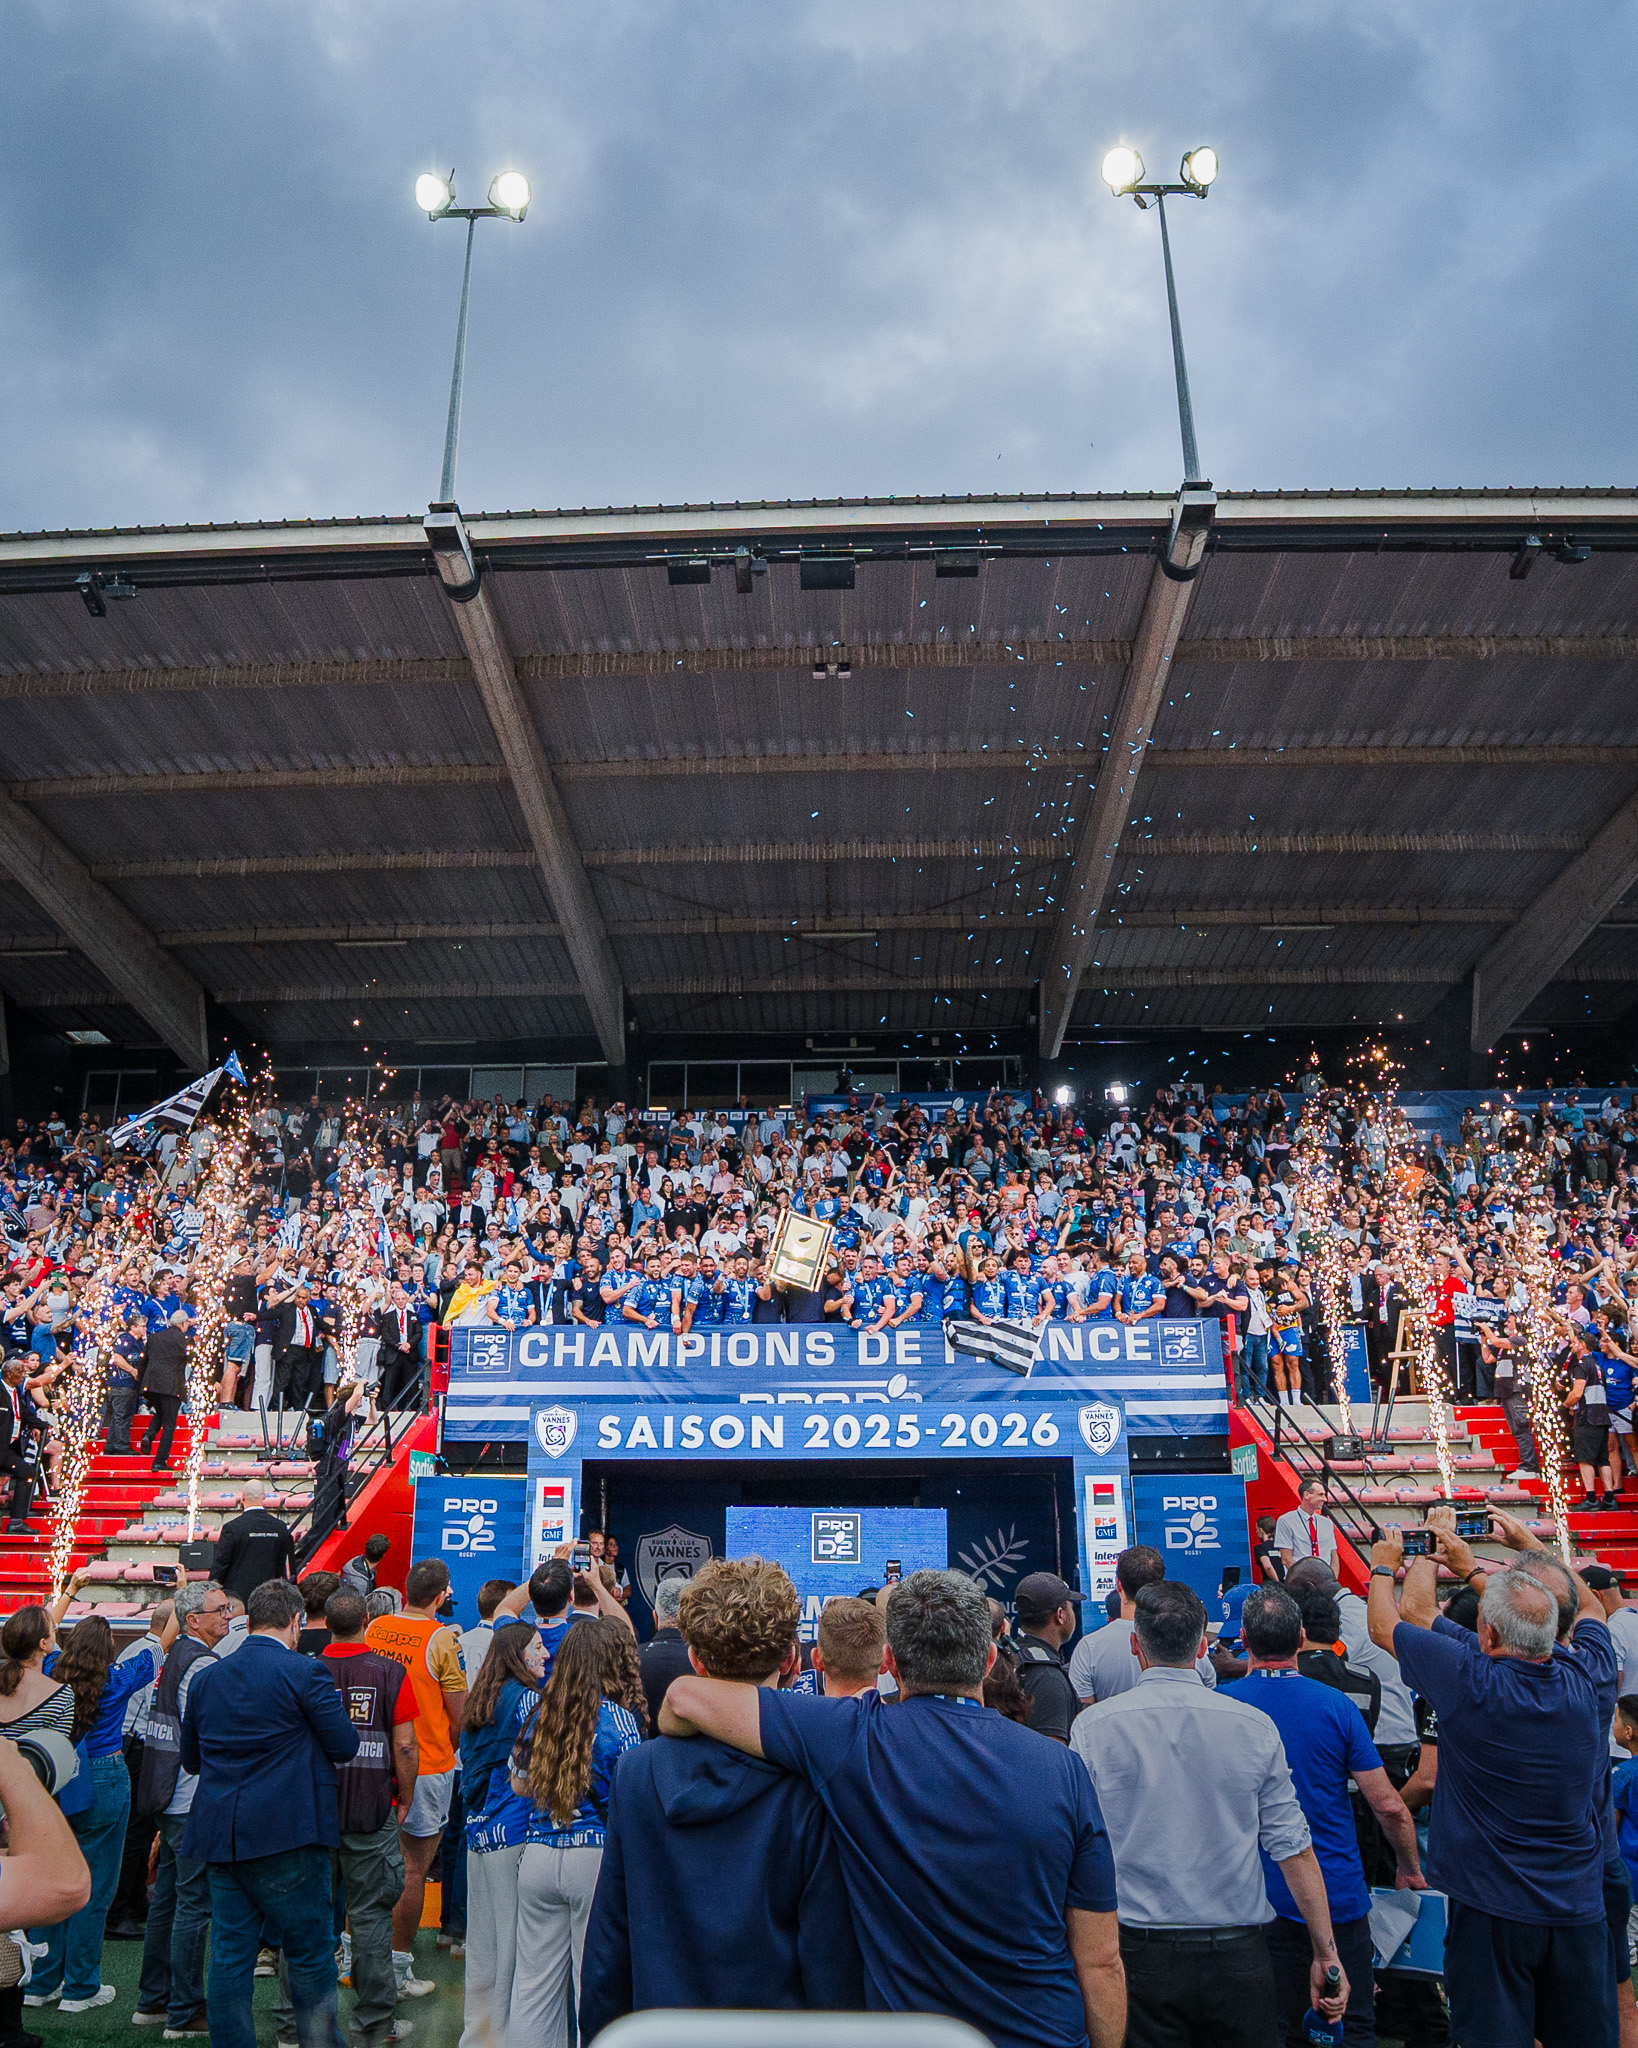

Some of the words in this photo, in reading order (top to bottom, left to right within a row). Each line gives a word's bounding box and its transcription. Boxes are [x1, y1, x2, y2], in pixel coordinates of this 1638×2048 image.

[1163, 1326, 1197, 1336] PRO
[473, 1334, 506, 1344] PRO
[519, 1330, 835, 1368] CHAMPIONS
[858, 1330, 922, 1366] DE
[944, 1325, 1152, 1364] NCE
[1164, 1344, 1200, 1358] D2
[472, 1352, 506, 1366] D2
[542, 1416, 571, 1424] VANNES
[597, 1414, 784, 1449] SAISON
[803, 1413, 1060, 1449] 2025-2026
[410, 1456, 435, 1479] sortie
[1233, 1449, 1258, 1475] sortie
[443, 1498, 498, 1514] PRO
[1162, 1495, 1218, 1512] PRO
[818, 1520, 854, 1531] PRO
[1096, 1528, 1116, 1537] GMF
[441, 1528, 497, 1552] D2
[543, 1530, 562, 1540] GMF
[1164, 1526, 1222, 1549] D2
[648, 1545, 701, 1558] VANNES
[817, 1539, 855, 1556] D2
[368, 1625, 422, 1648] Kappa
[350, 1692, 372, 1701] TOP
[349, 1708, 369, 1721] 14
[356, 1740, 384, 1758] ATCH
